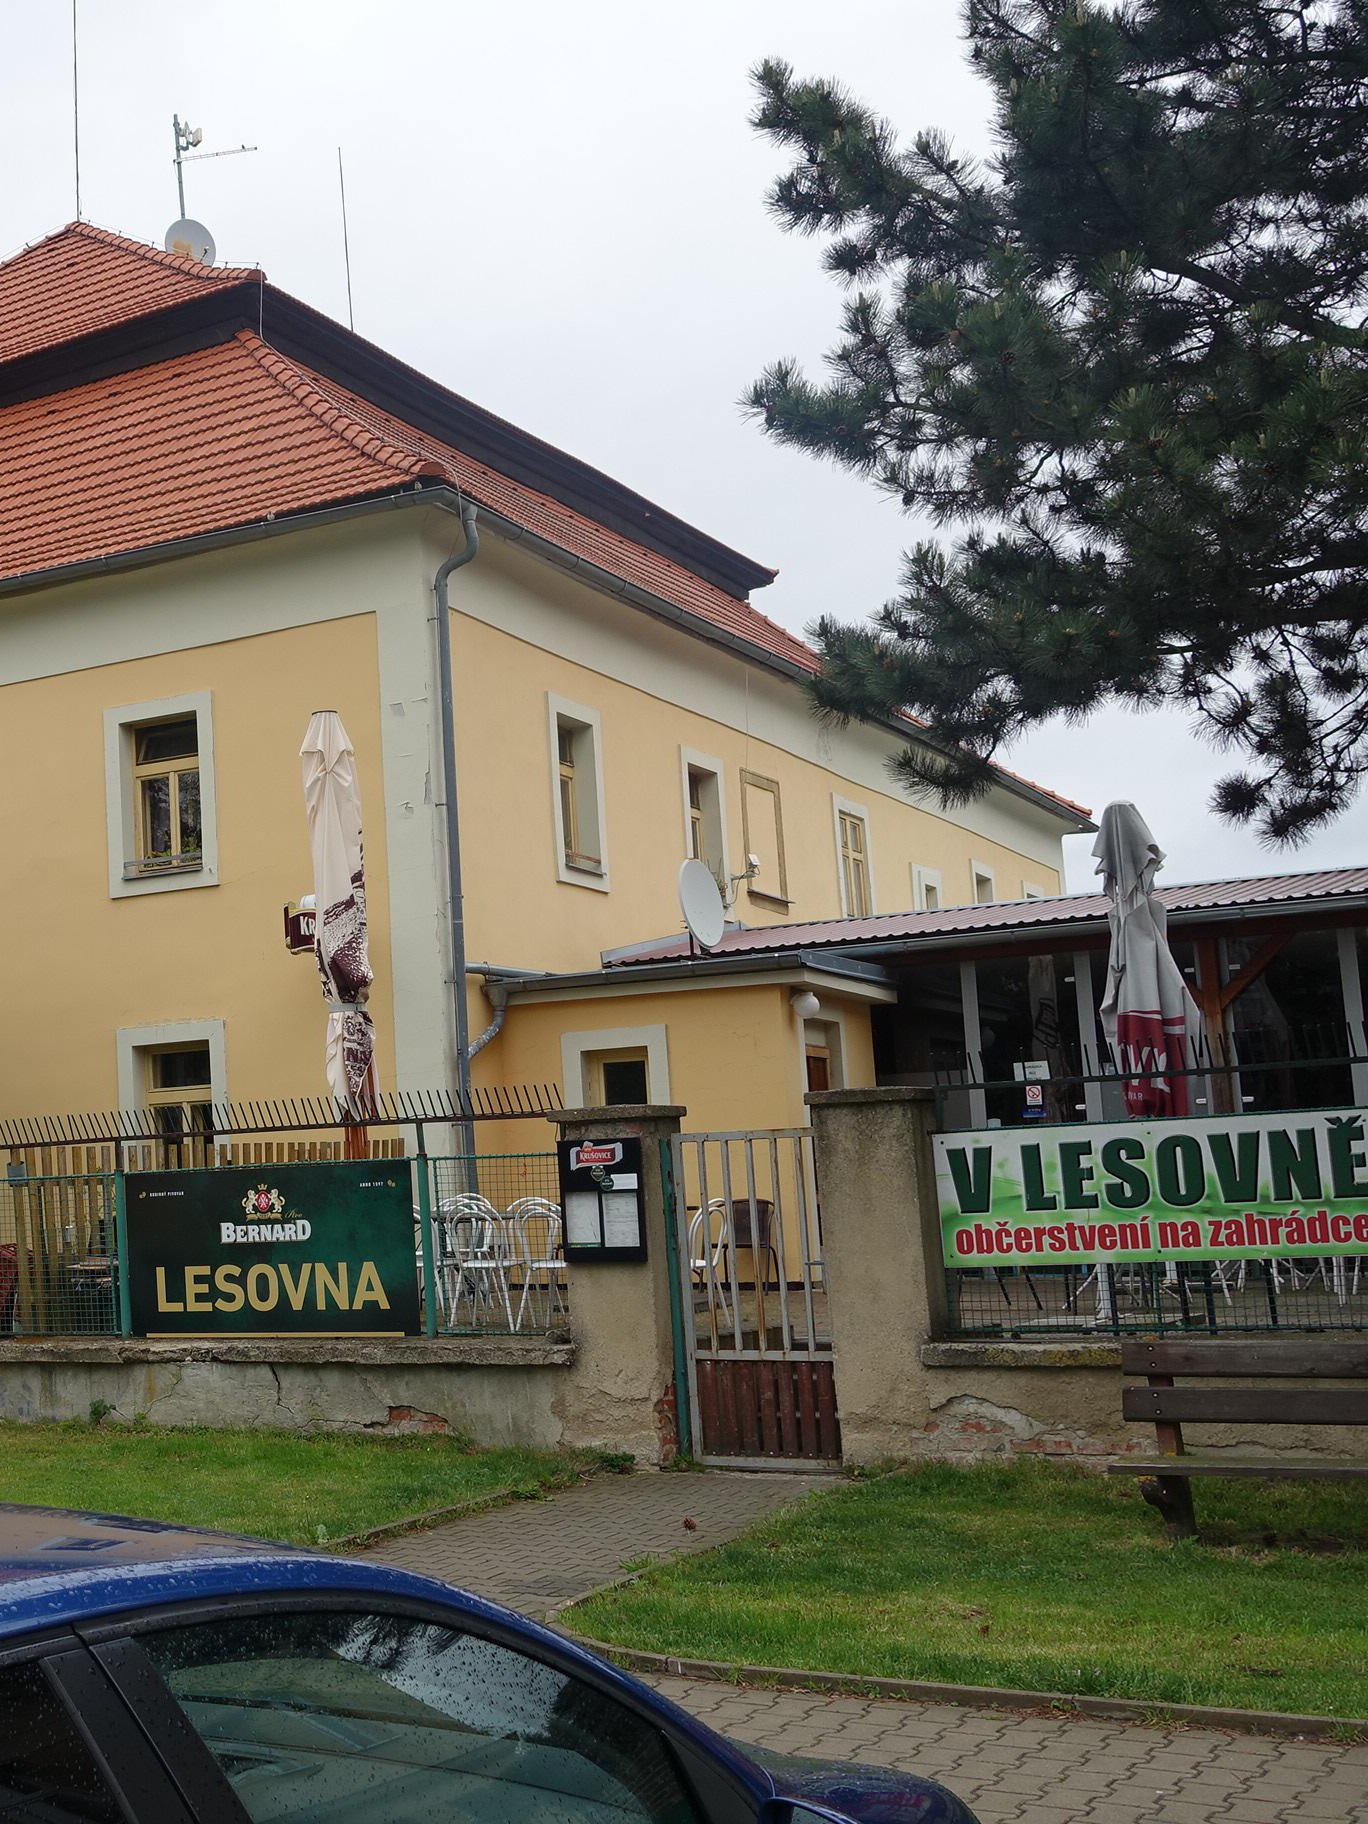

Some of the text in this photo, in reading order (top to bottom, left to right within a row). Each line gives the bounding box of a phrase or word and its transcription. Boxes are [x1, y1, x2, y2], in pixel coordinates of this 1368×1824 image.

[944, 1114, 1368, 1214] V LESOVNĚ
[219, 1219, 312, 1244] BERNARD
[955, 1210, 1368, 1256] občerstvení na zahrádce
[155, 1261, 391, 1313] LESOVNA
